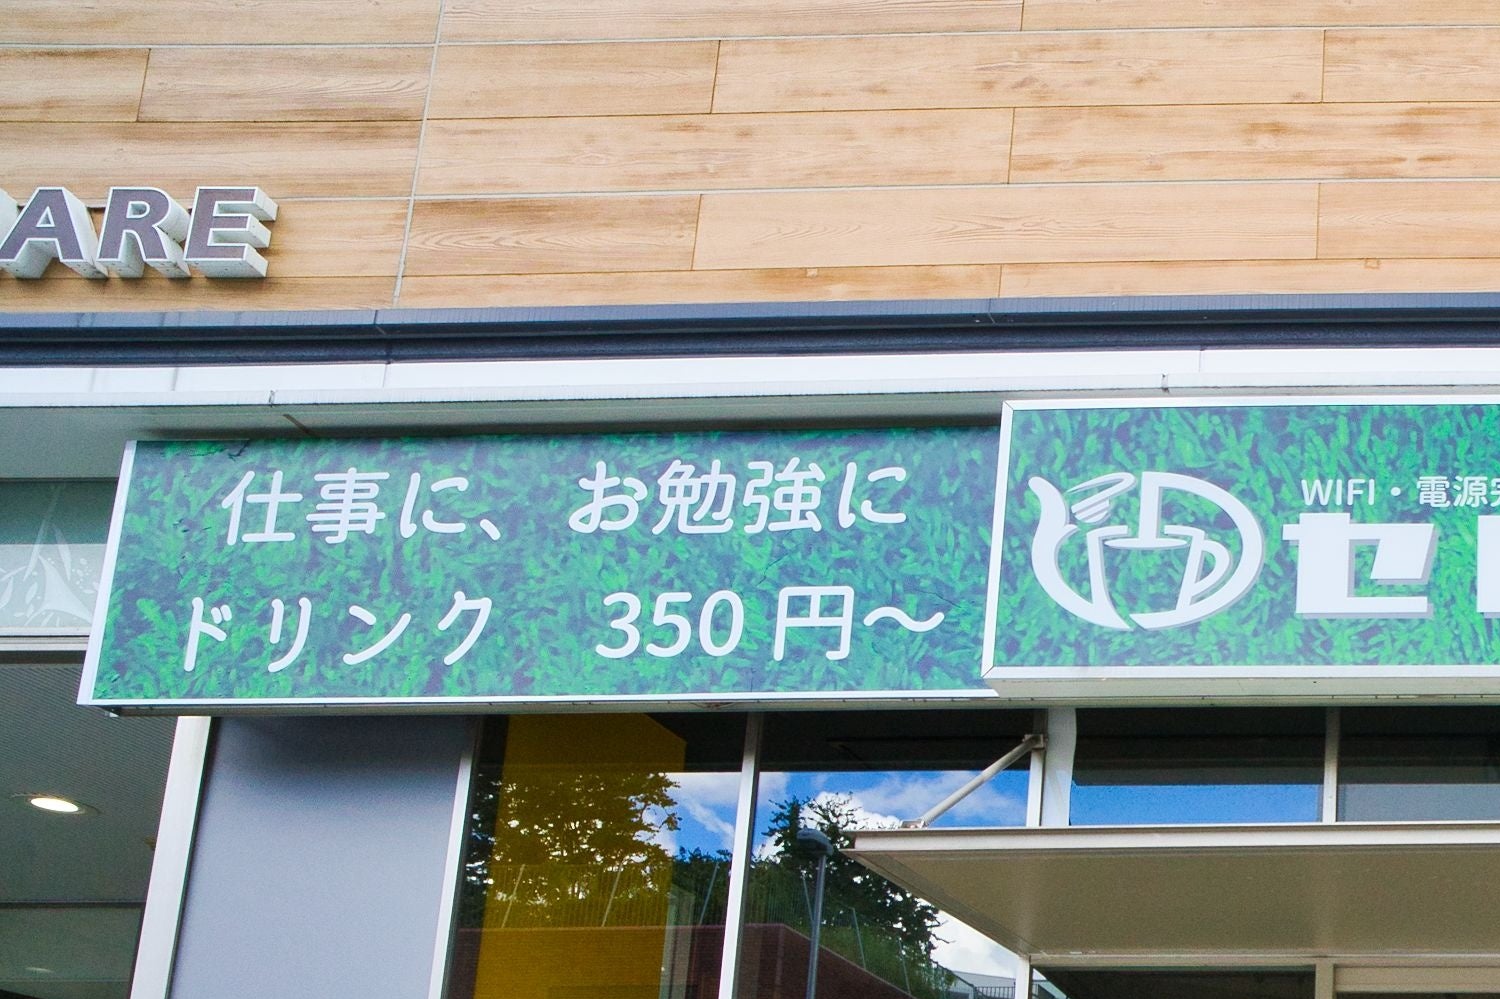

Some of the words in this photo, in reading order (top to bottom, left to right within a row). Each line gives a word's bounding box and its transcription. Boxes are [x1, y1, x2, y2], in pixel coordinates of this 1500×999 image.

[0, 186, 278, 278] ARE
[220, 469, 504, 547] 仕事に、
[567, 458, 909, 537] お勉強に
[181, 590, 494, 674] ドリンク
